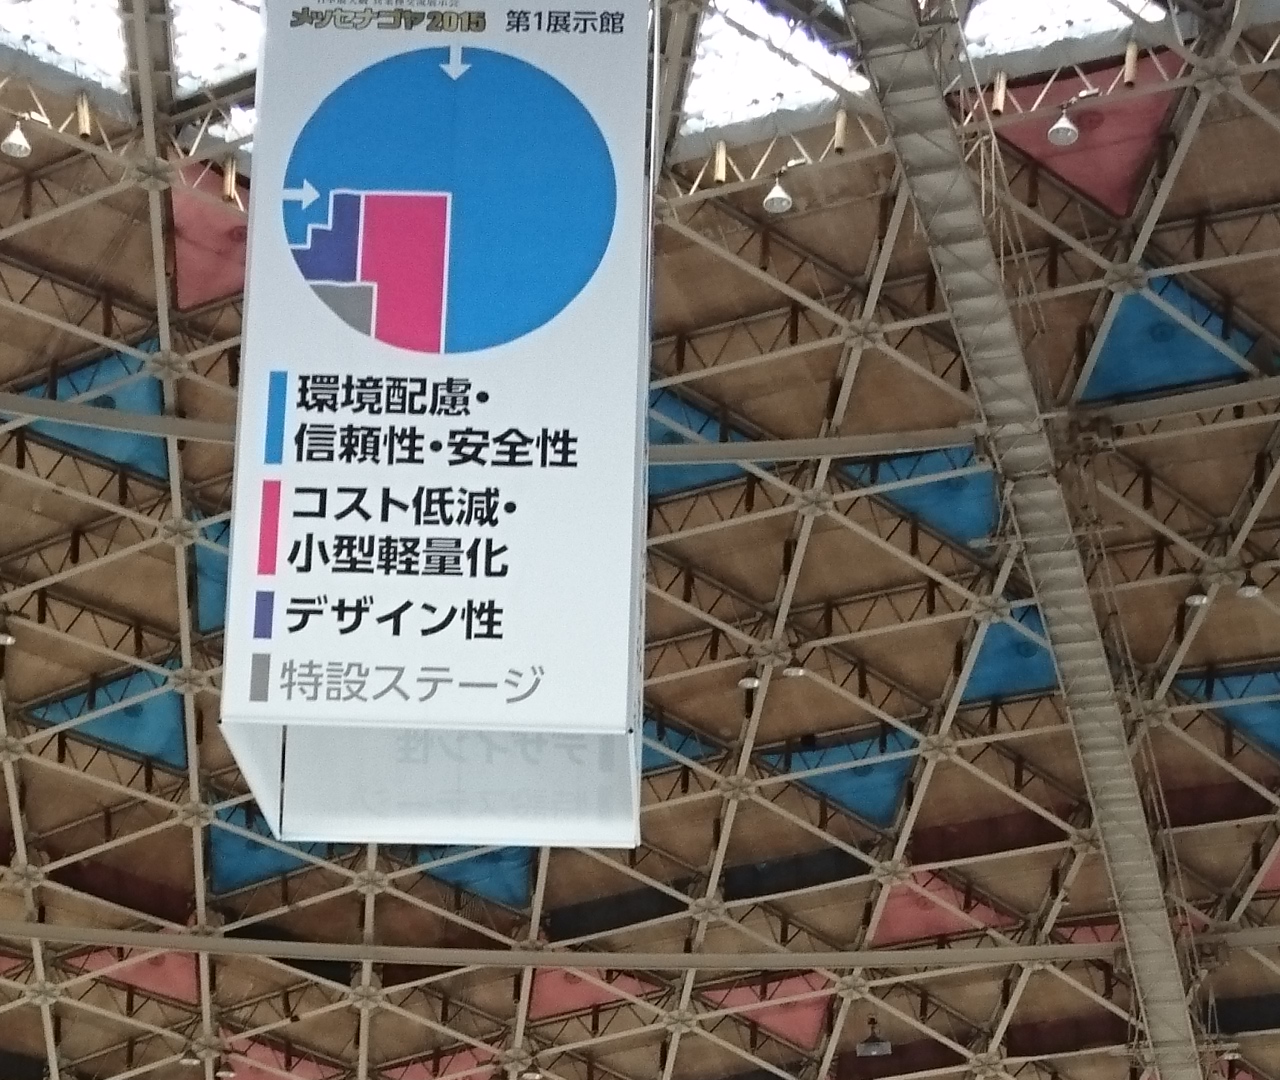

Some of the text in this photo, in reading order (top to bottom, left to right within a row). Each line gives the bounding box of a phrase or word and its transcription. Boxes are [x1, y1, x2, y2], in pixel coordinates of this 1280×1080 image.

[506, 9, 625, 33] 第1展示館
[296, 374, 490, 416] 環境配慮・
[294, 423, 578, 468] 信頼性・安全性
[292, 485, 517, 527] コスト低減・
[287, 532, 509, 578] 小型軽量化
[286, 594, 504, 640] デザイン性
[280, 659, 545, 704] 特設ステージ
